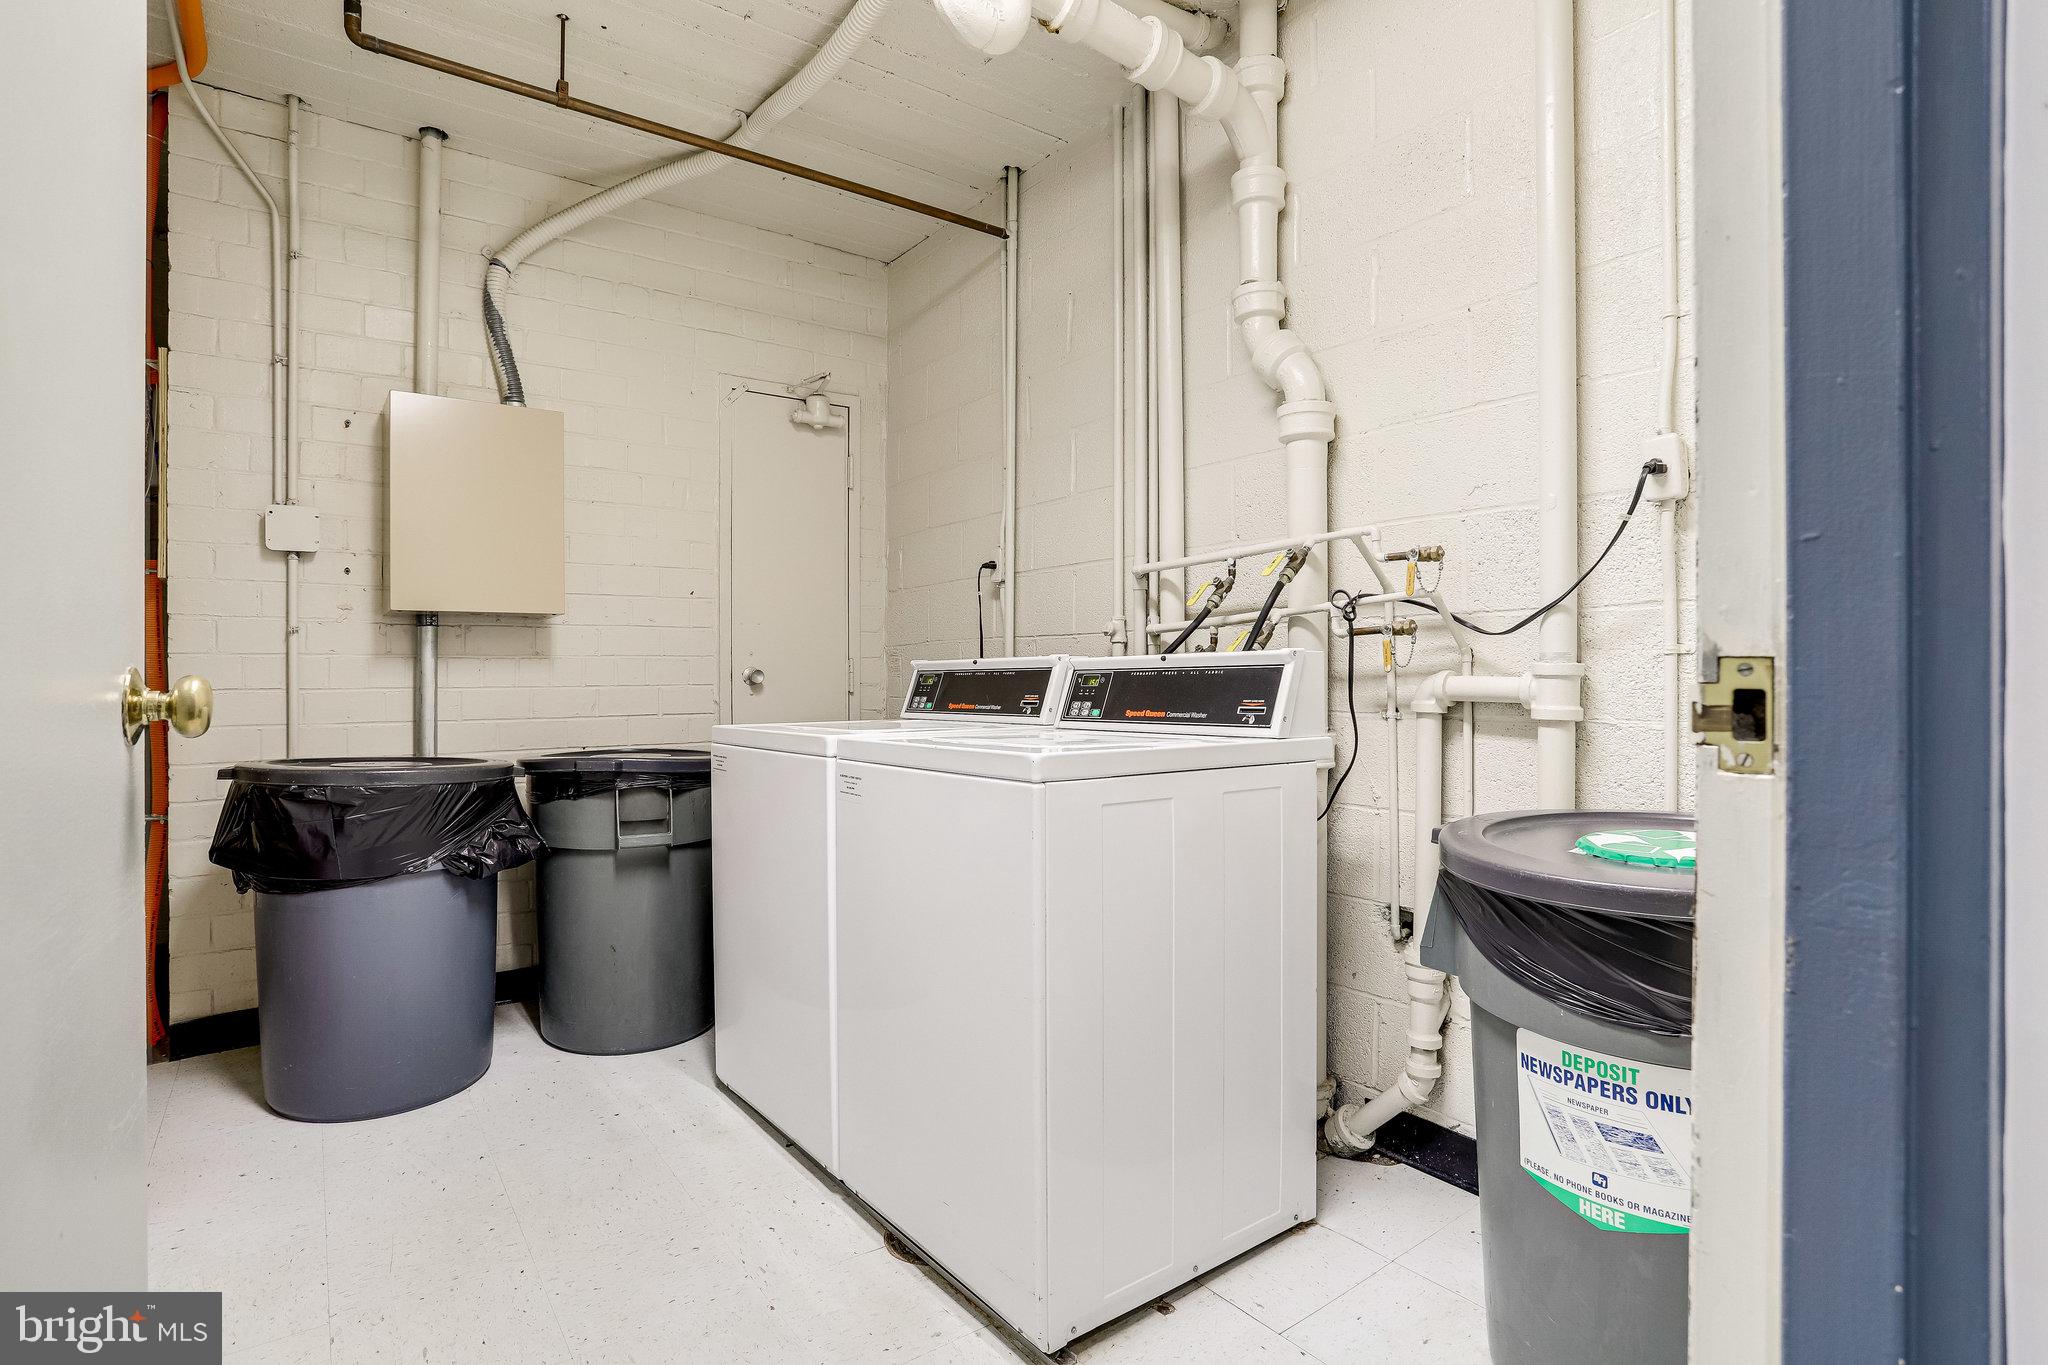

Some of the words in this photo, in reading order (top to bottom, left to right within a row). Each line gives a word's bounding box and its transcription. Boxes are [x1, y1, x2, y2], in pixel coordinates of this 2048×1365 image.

[1125, 709, 1146, 718] Speed
[1145, 709, 1166, 718] Queen
[1520, 1051, 1638, 1105] NEWSPAPERS
[1561, 1050, 1640, 1086] DEPOSIT
[1567, 1097, 1609, 1116] NEWSPAPER
[1553, 1173, 1564, 1184] NO
[1566, 1178, 1593, 1196] PHONE
[1595, 1190, 1624, 1207] BOOKS
[1627, 1200, 1640, 1211] OR
[1578, 1198, 1626, 1230] HERE
